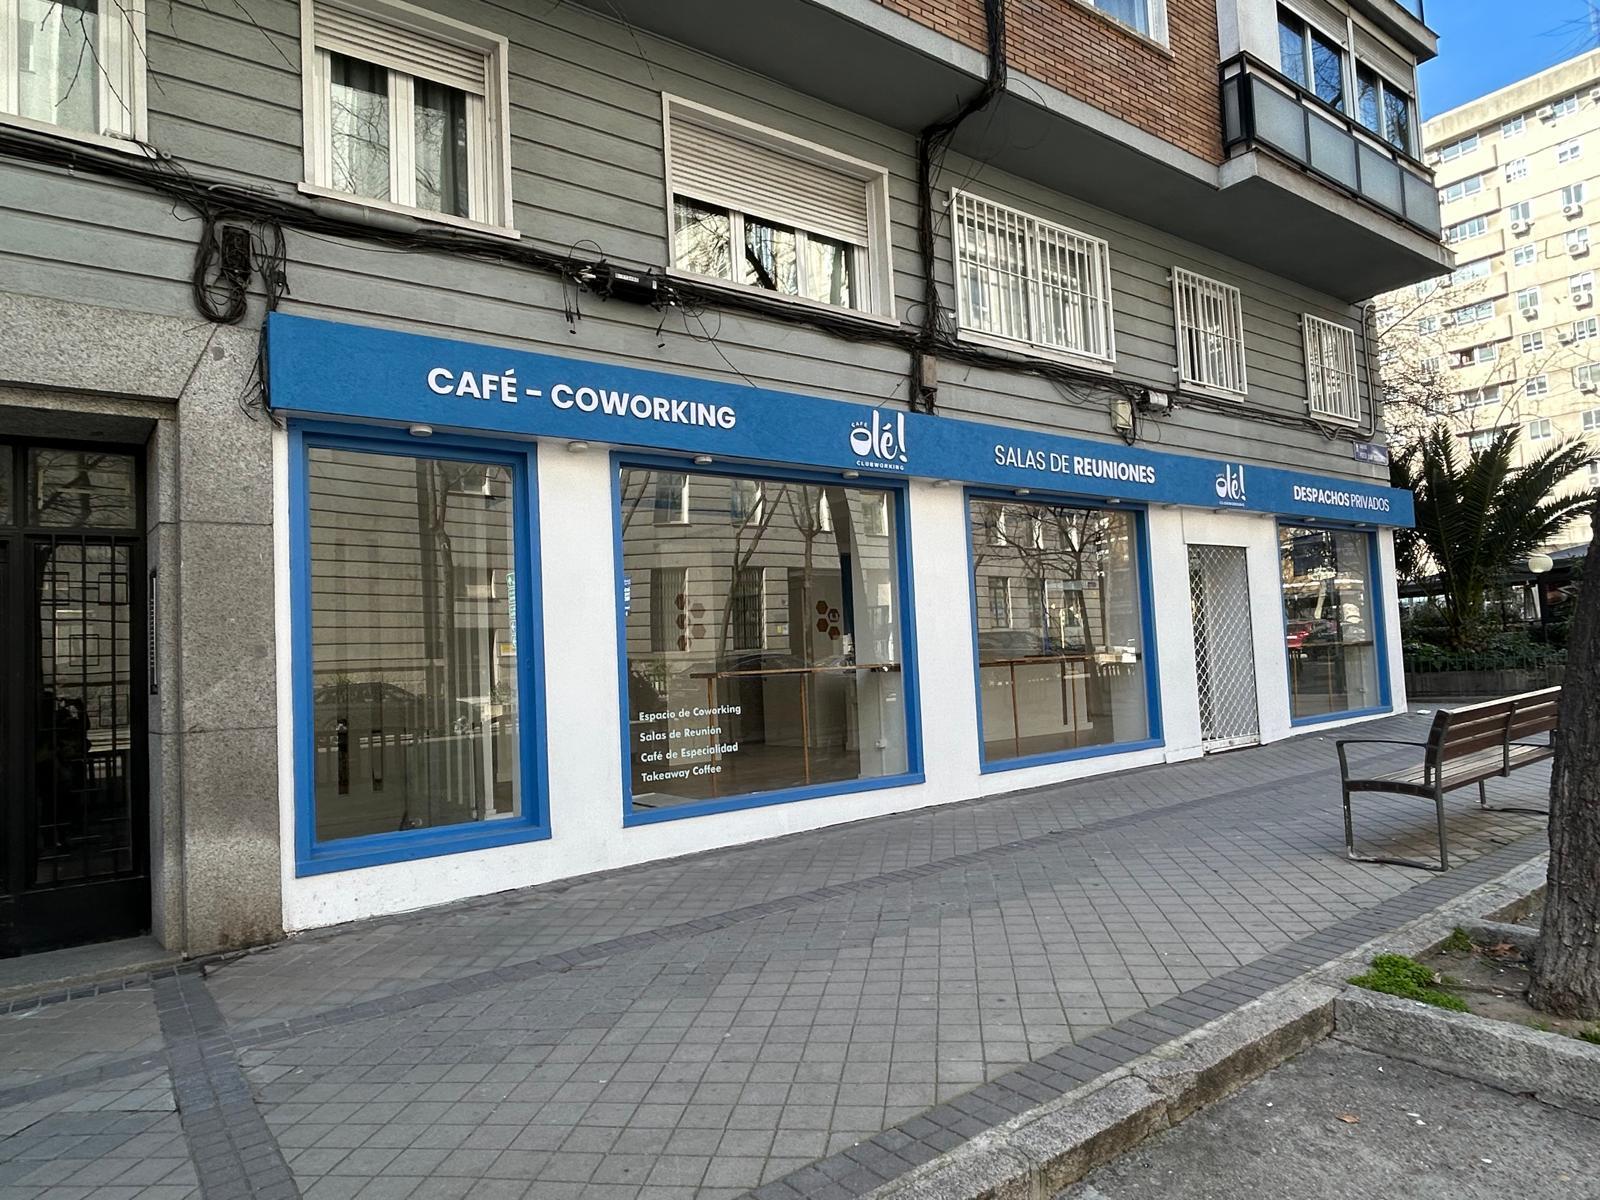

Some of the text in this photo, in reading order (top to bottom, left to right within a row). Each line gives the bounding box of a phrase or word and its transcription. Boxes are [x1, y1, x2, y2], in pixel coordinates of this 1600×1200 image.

[427, 367, 518, 403] CAFÉ
[551, 384, 736, 429] COWORKING
[995, 444, 1156, 484] SALAS DE REUNIONES
[1293, 485, 1390, 512] DESPACHOS PRIVADOS
[639, 705, 741, 722] Espacio de Coworking
[640, 726, 722, 742] Salas de Reunión
[641, 742, 739, 763] Café de Especialidad
[641, 765, 722, 782] Takeaway Coffee
